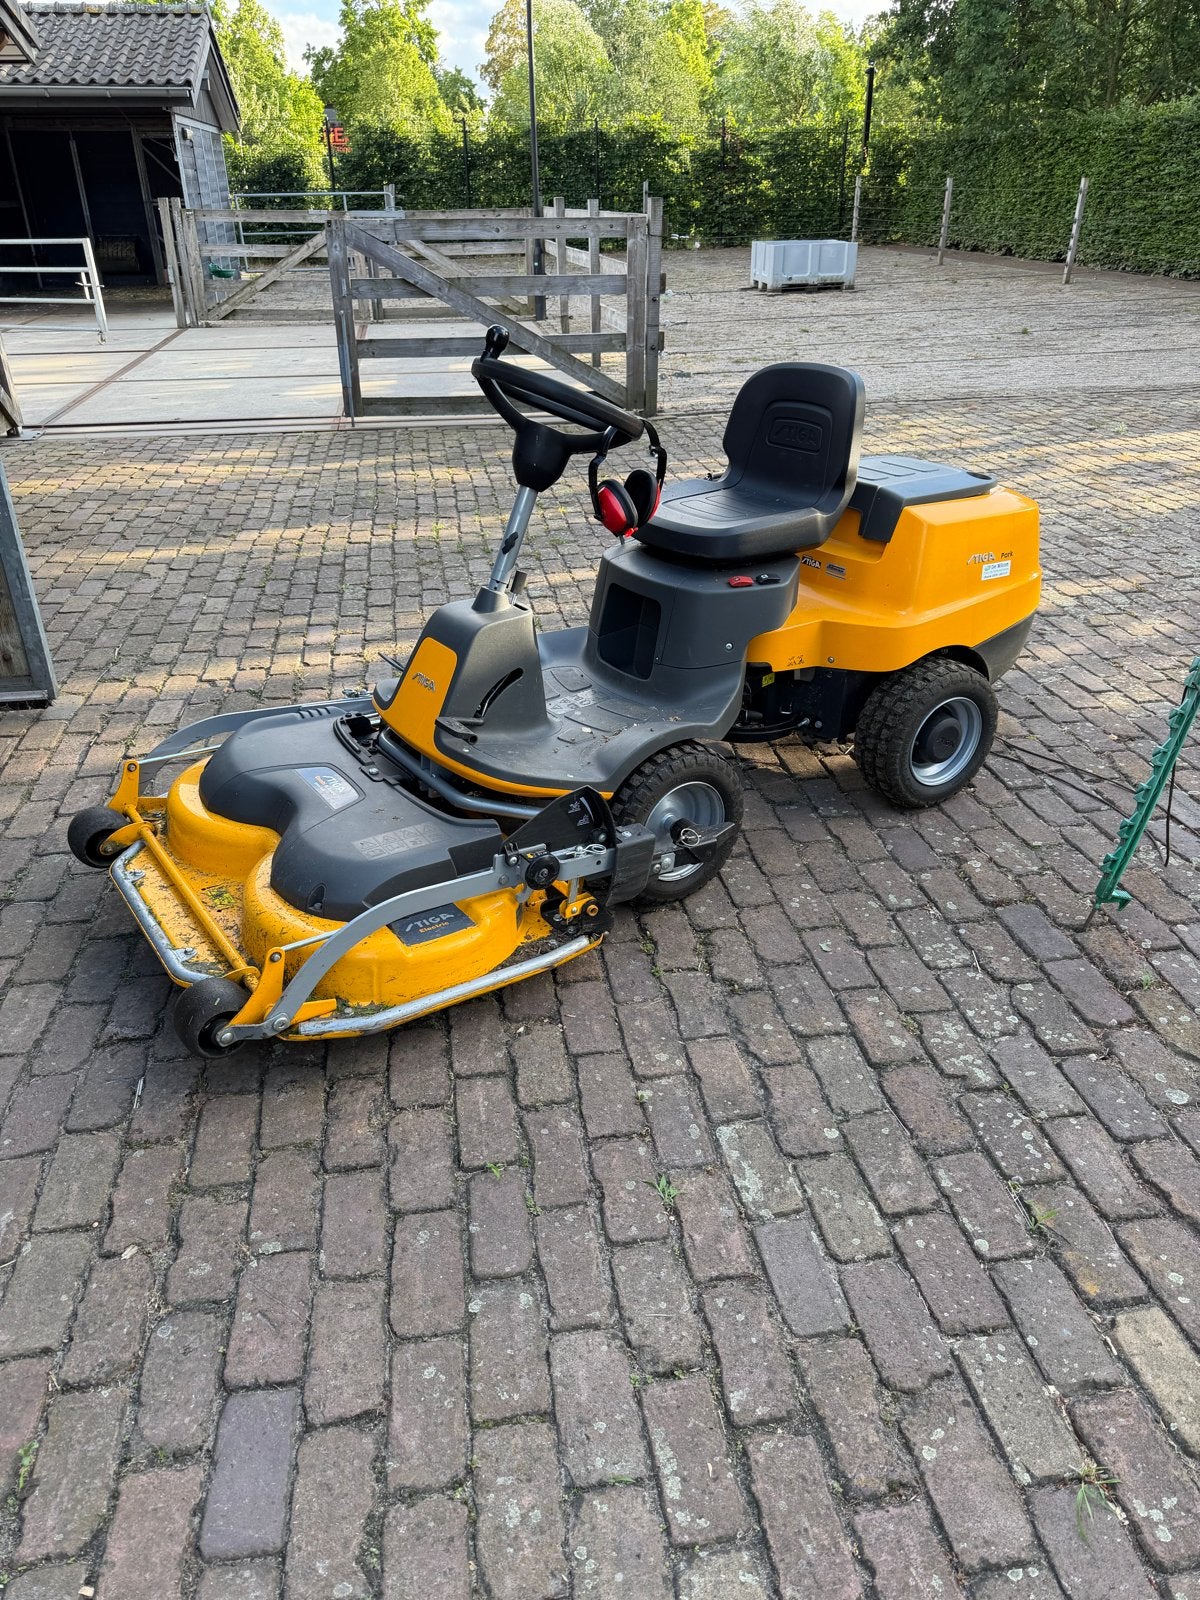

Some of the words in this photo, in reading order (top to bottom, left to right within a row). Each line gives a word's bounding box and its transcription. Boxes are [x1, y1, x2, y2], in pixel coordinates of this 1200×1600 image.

[801, 556, 821, 569] STIGA
[967, 551, 995, 565] STIGA
[405, 913, 455, 932] STIGA
[418, 921, 450, 933] Electric
